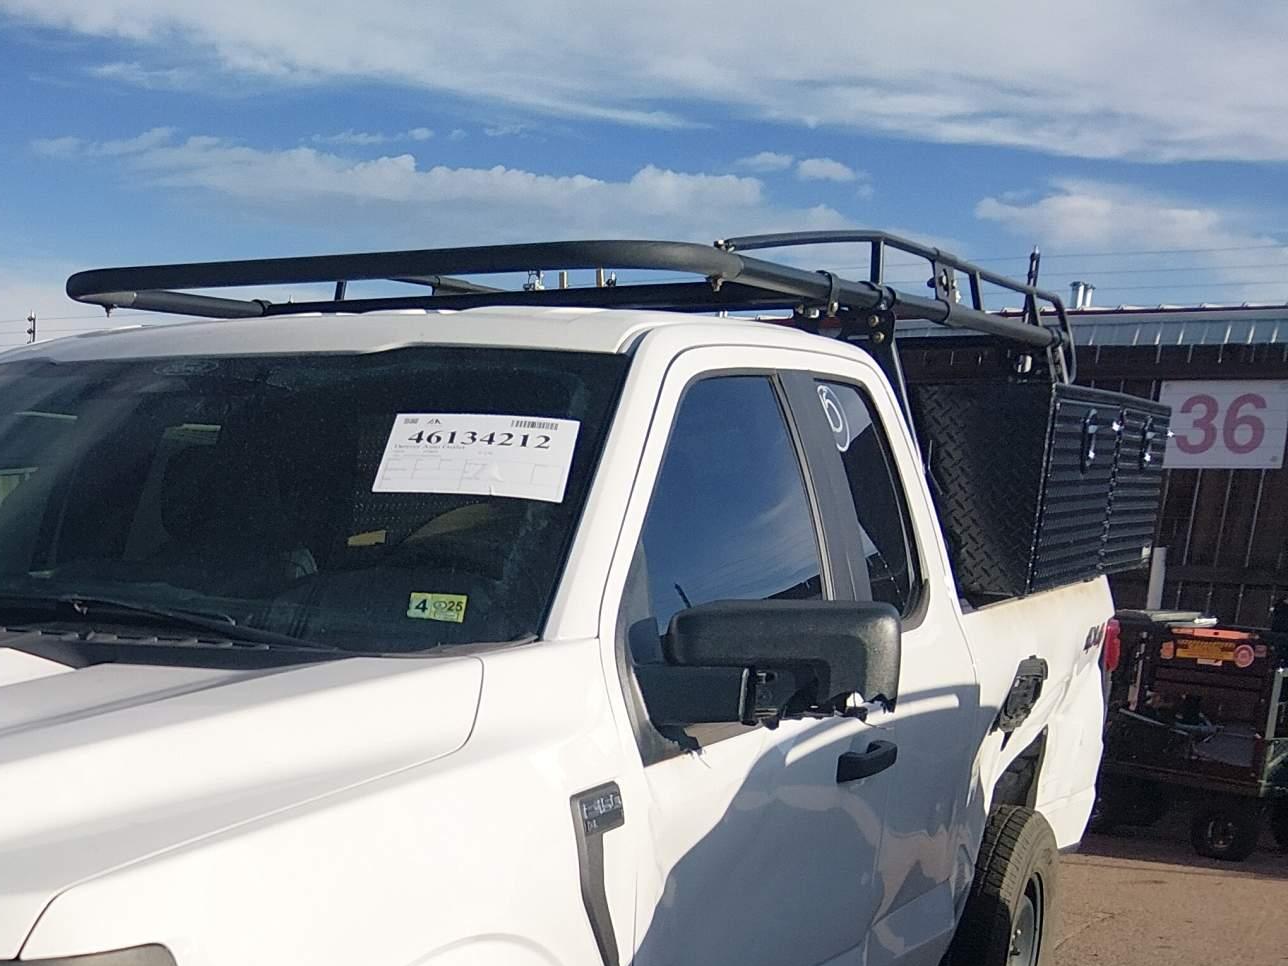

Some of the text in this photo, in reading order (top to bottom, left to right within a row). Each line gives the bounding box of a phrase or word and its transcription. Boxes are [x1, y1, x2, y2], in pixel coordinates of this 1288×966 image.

[1175, 393, 1267, 454] 36
[407, 430, 551, 449] 46134212
[415, 599, 428, 613] 4
